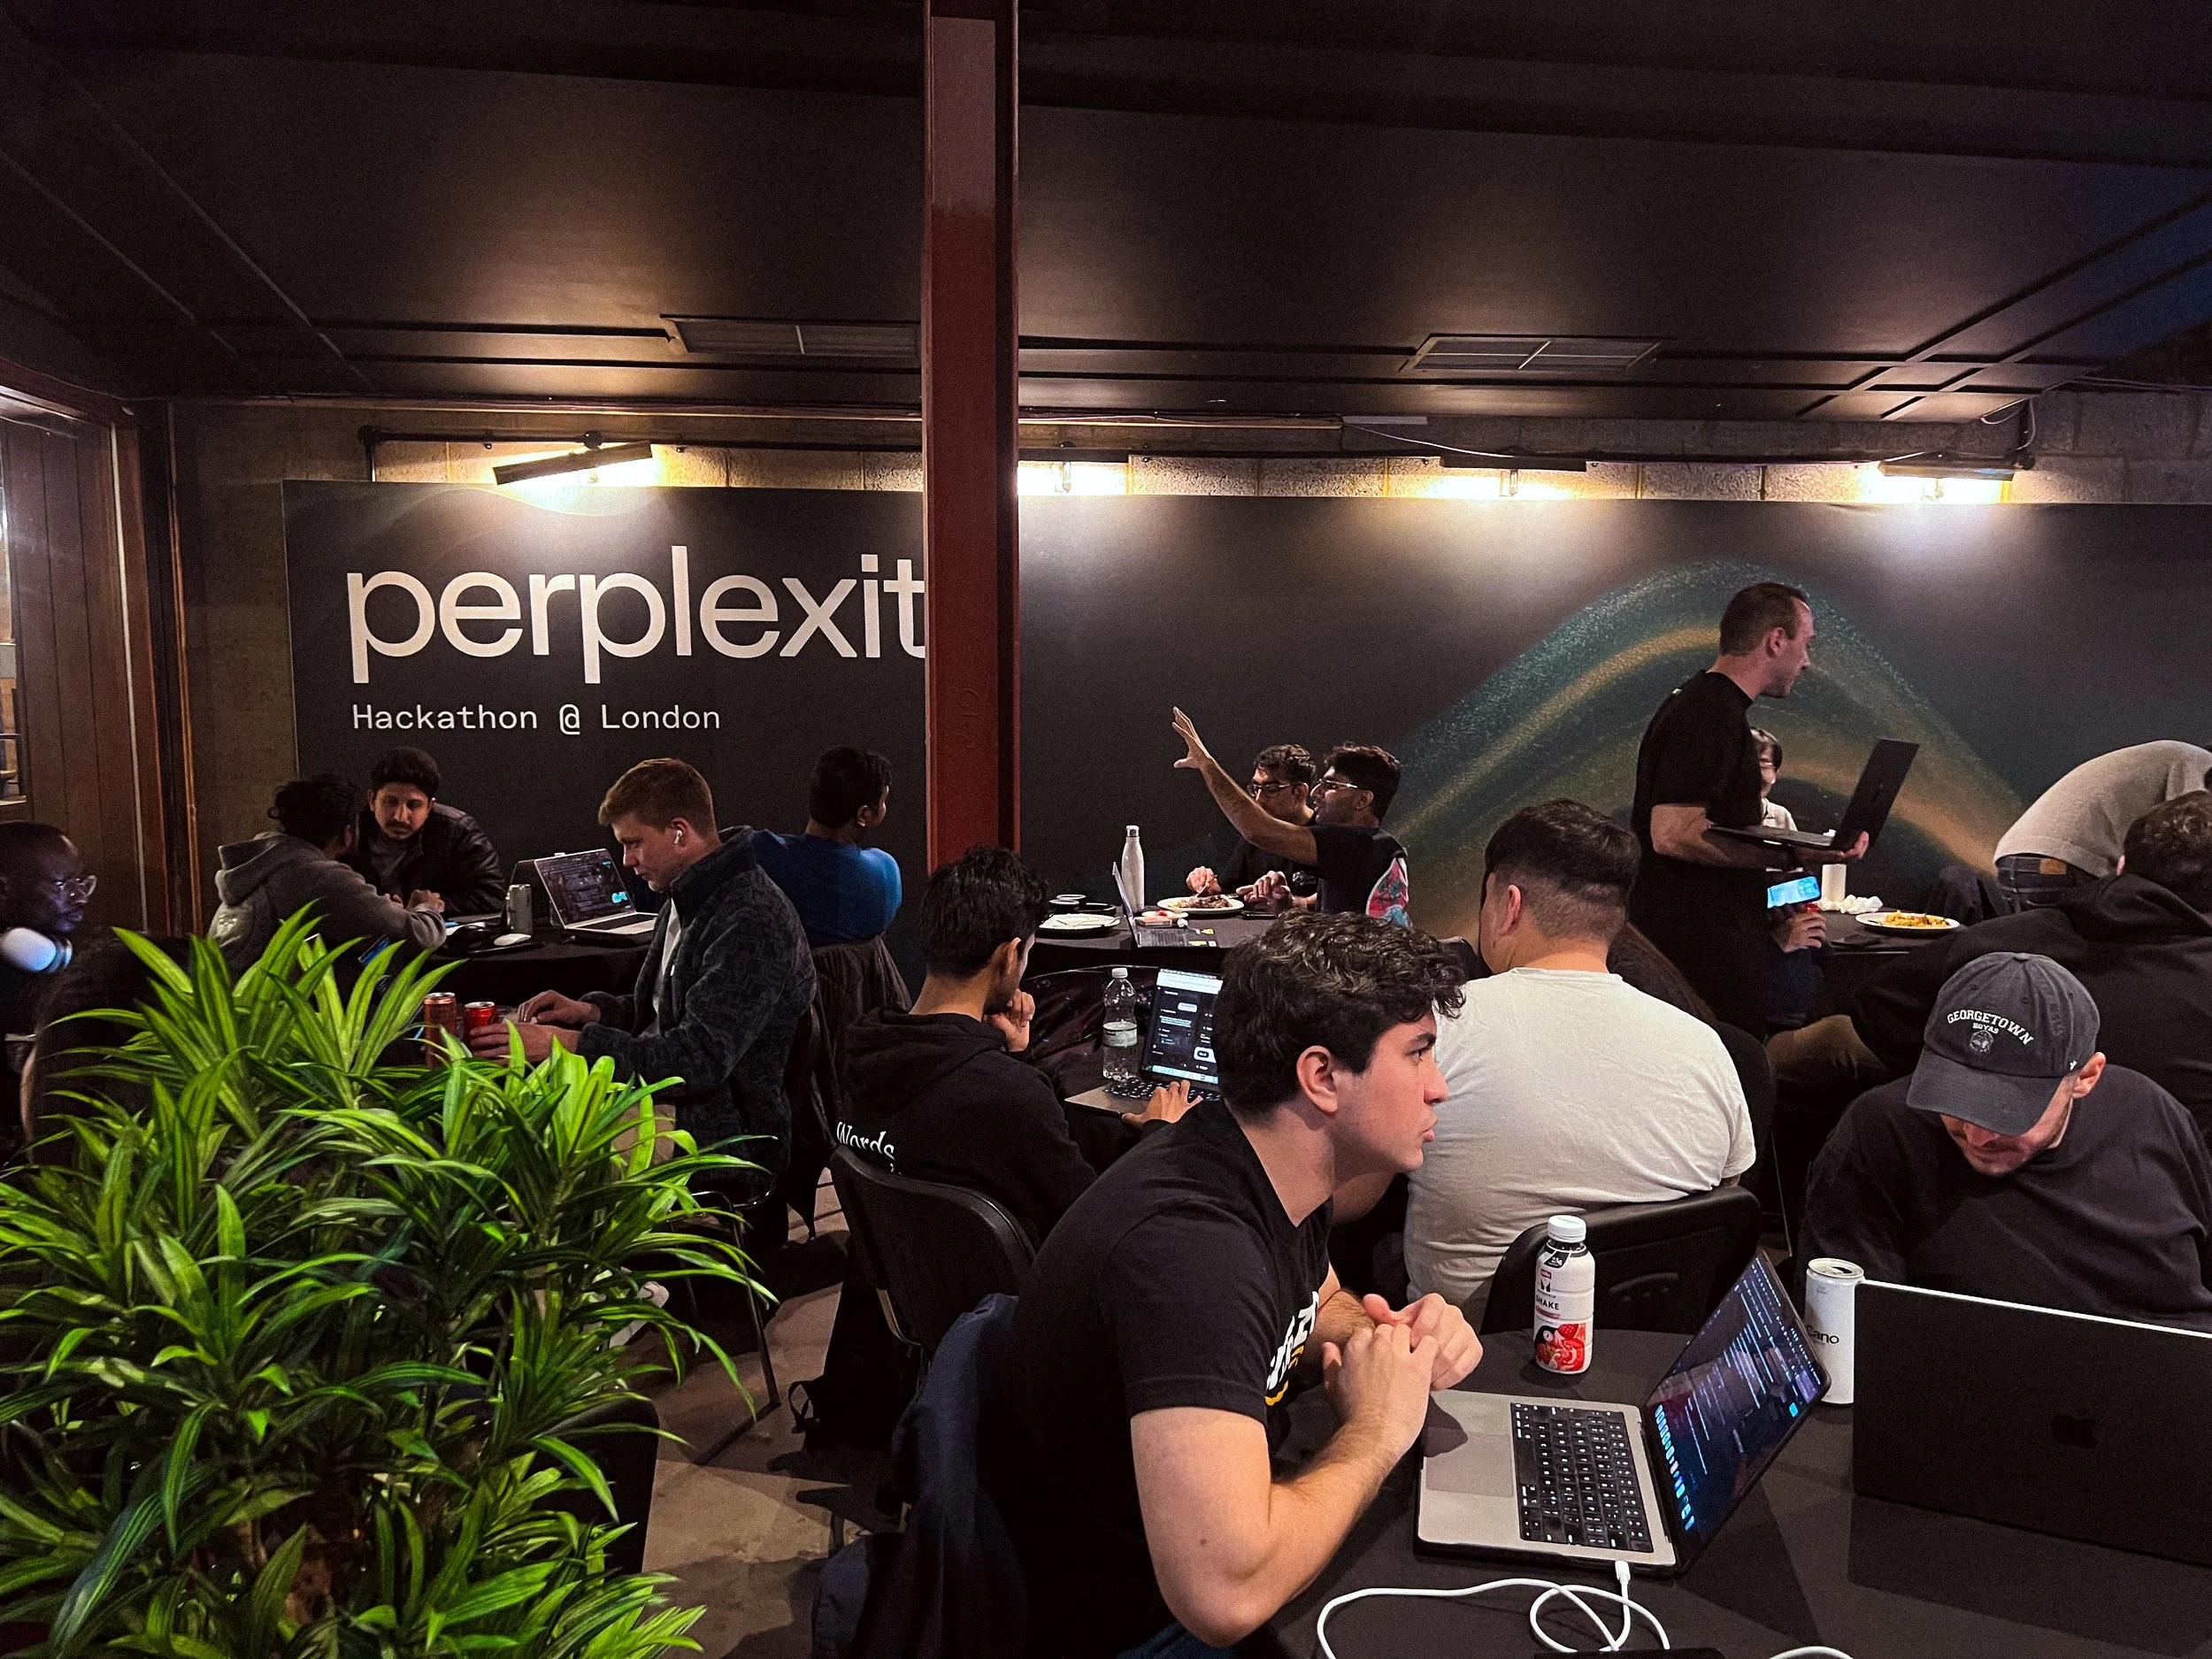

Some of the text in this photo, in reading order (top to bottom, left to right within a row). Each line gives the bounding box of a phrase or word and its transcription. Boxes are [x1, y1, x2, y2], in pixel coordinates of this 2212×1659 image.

[353, 704, 721, 735] Hackathon @ London
[1947, 1010, 2034, 1045] GEORGETOWN
